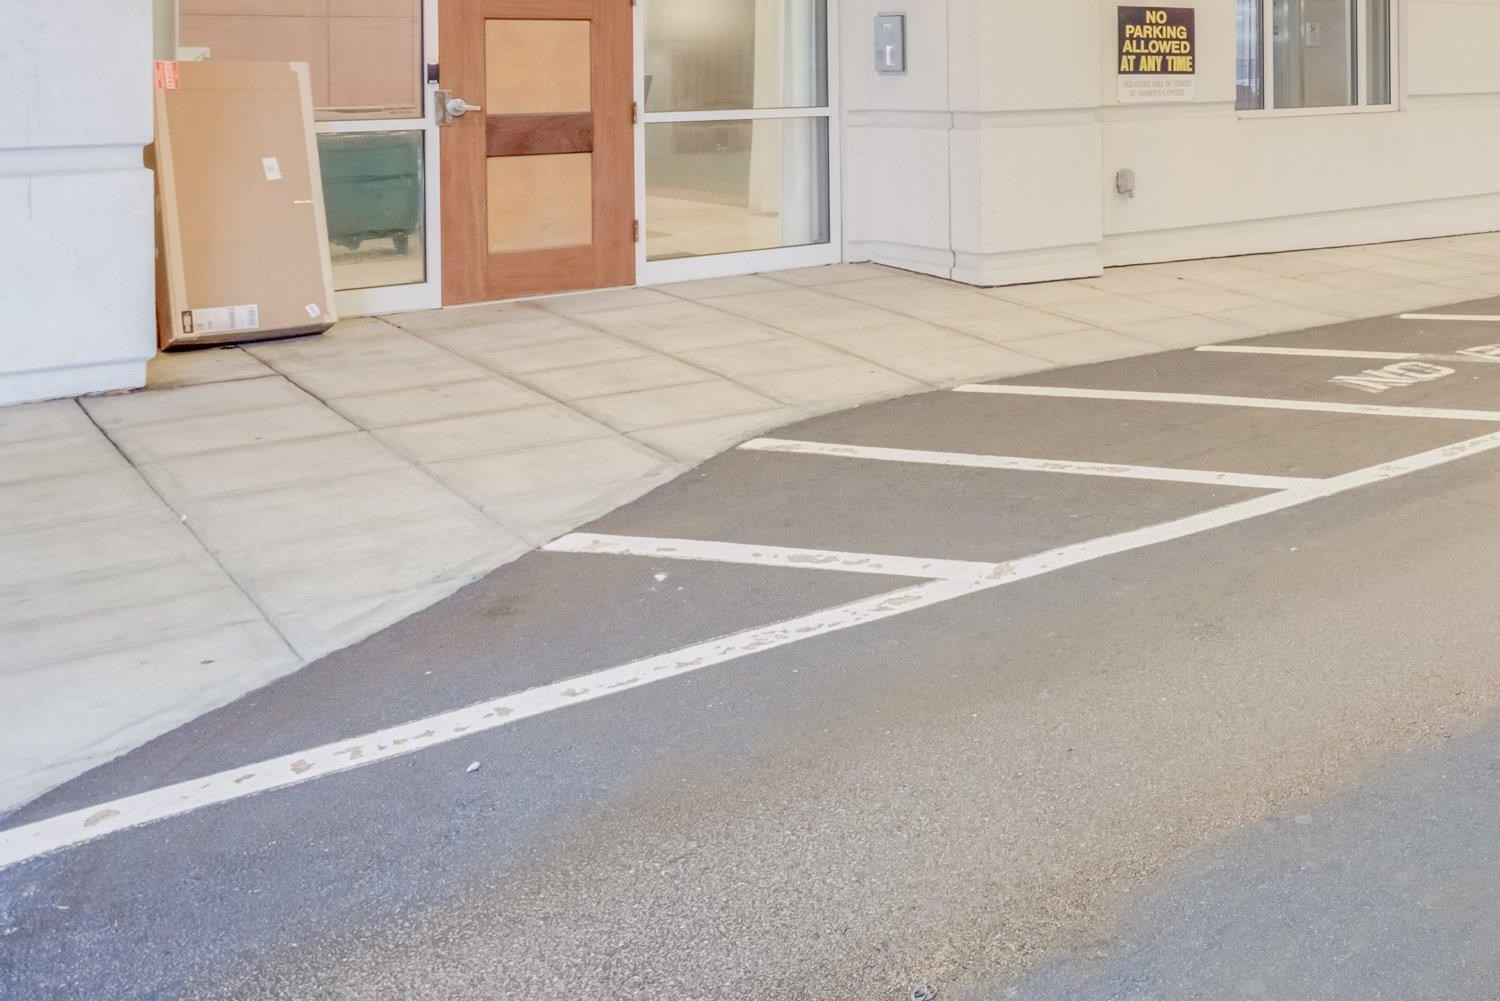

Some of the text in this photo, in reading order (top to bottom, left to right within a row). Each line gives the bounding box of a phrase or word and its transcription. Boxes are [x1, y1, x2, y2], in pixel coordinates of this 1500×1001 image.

[1145, 10, 1168, 24] NO
[1125, 25, 1188, 39] PARKING
[1122, 40, 1191, 54] ALLOWED
[1120, 55, 1193, 72] AT ANY TIME
[1327, 360, 1456, 394] NO
